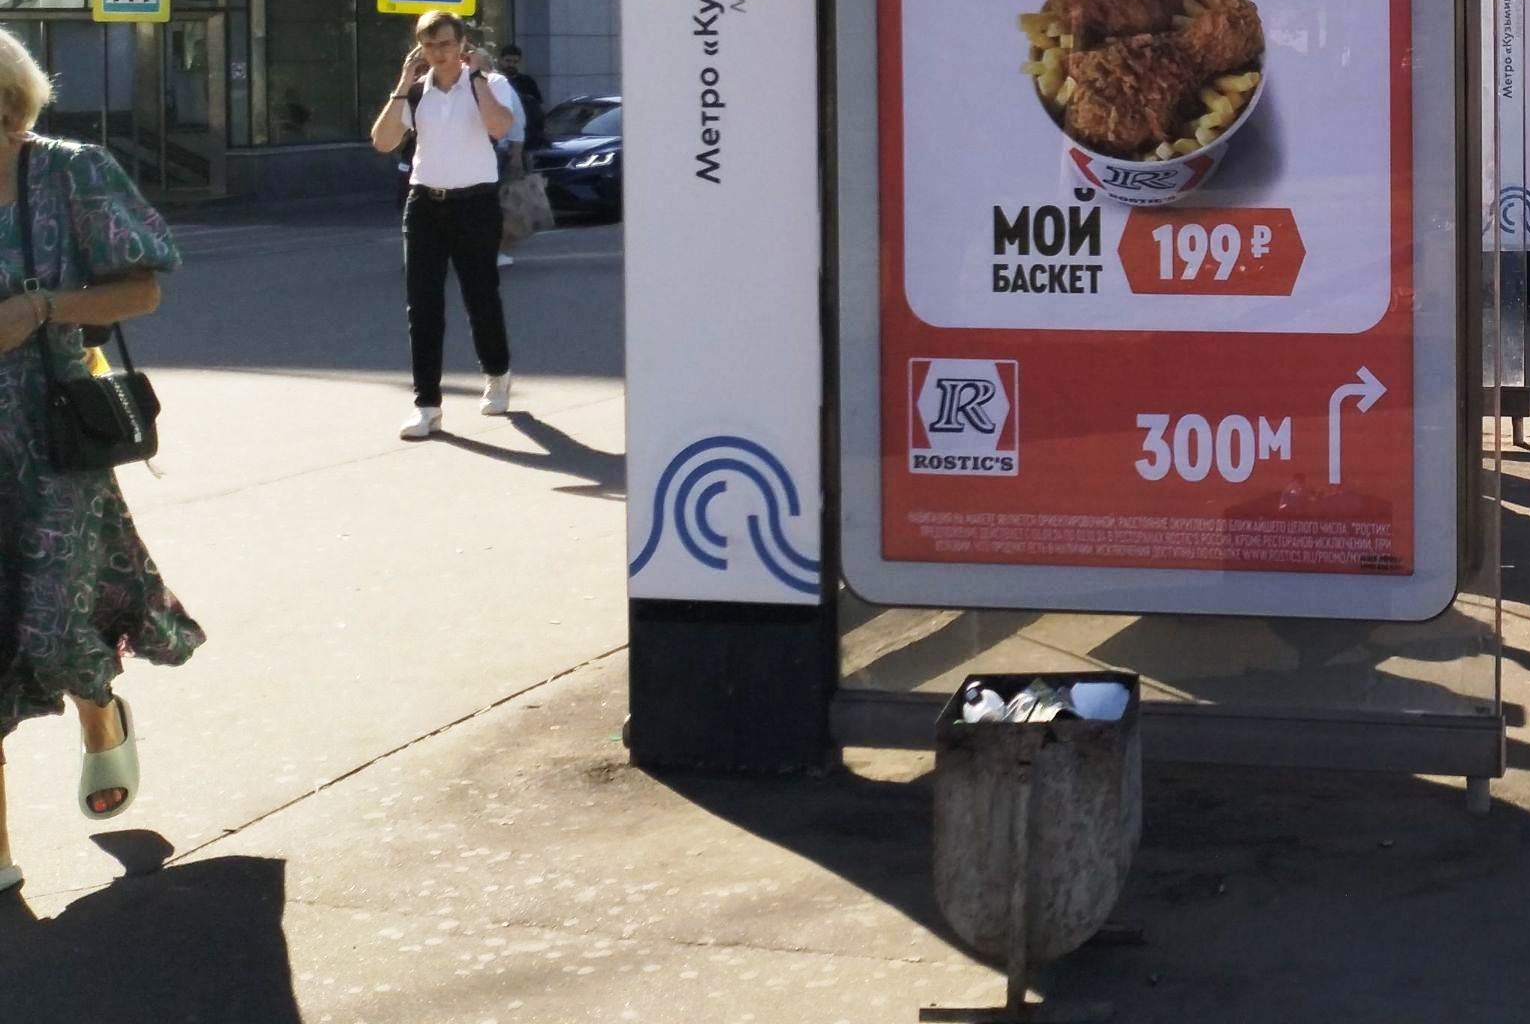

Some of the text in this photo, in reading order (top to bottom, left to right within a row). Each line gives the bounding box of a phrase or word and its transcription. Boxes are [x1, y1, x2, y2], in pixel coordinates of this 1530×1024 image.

[1502, 57, 1515, 99] Метро
[695, 67, 726, 184] Метро
[993, 186, 1102, 257] МОЙ
[992, 264, 1103, 294] БАСКЕТ
[913, 452, 1014, 473] ROSTIC'S
